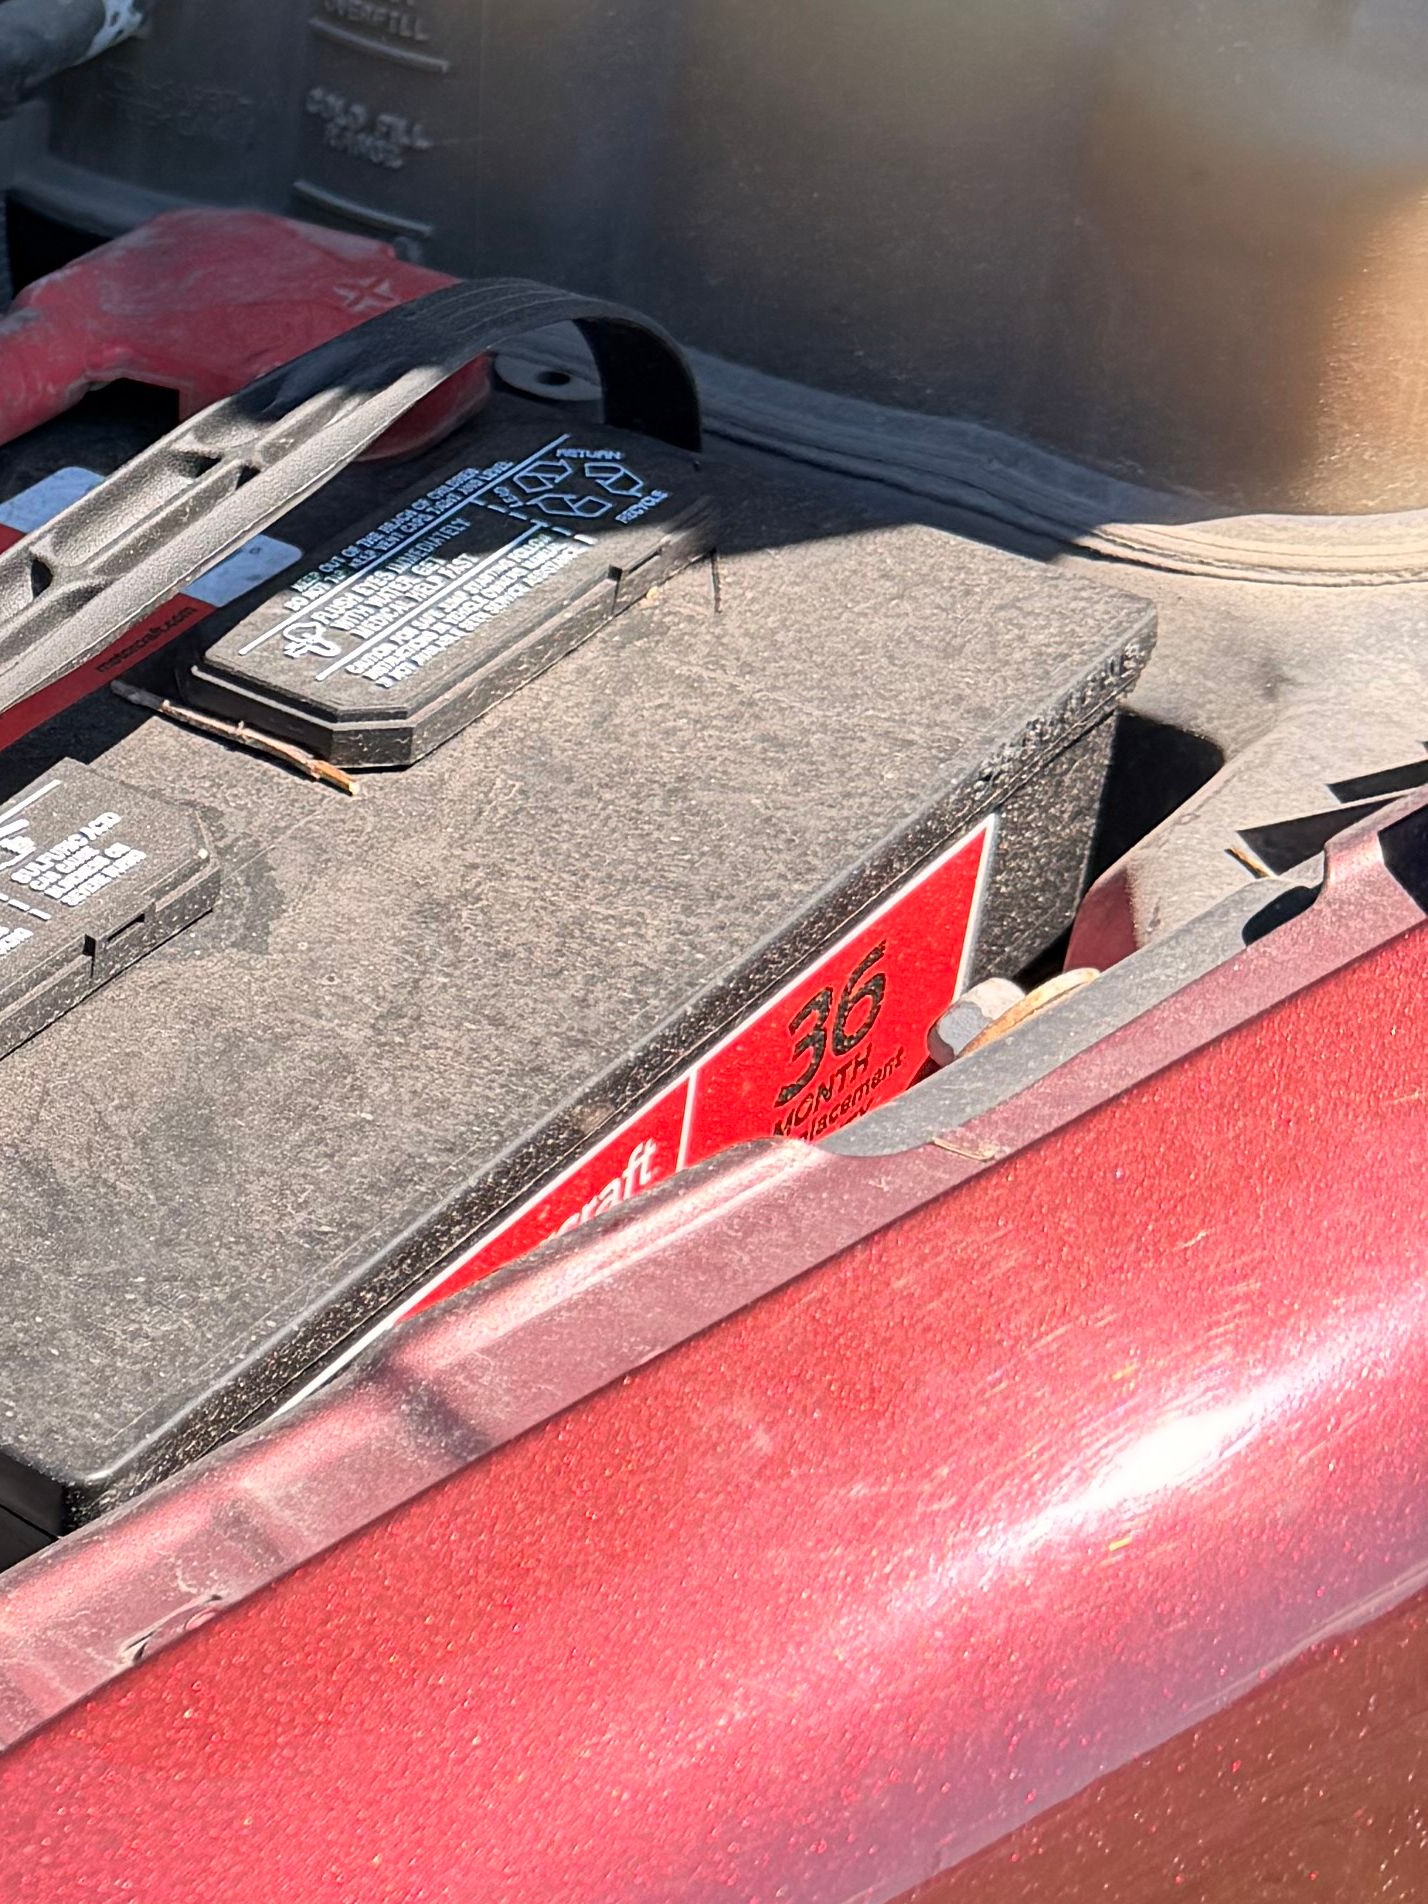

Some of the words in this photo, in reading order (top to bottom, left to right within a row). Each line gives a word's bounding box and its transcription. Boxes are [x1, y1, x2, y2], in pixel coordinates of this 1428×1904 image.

[310, 591, 364, 626] FLUSH
[351, 569, 398, 597] EYES
[384, 517, 471, 575] IMMEDIATELY
[328, 602, 376, 633] WITH
[349, 598, 417, 640] MEDICAL
[405, 574, 446, 603] HELP
[438, 552, 482, 583] FAST
[774, 939, 888, 1108] 36
[773, 1042, 873, 1137] MONTH
[799, 1046, 904, 1143] lacement
